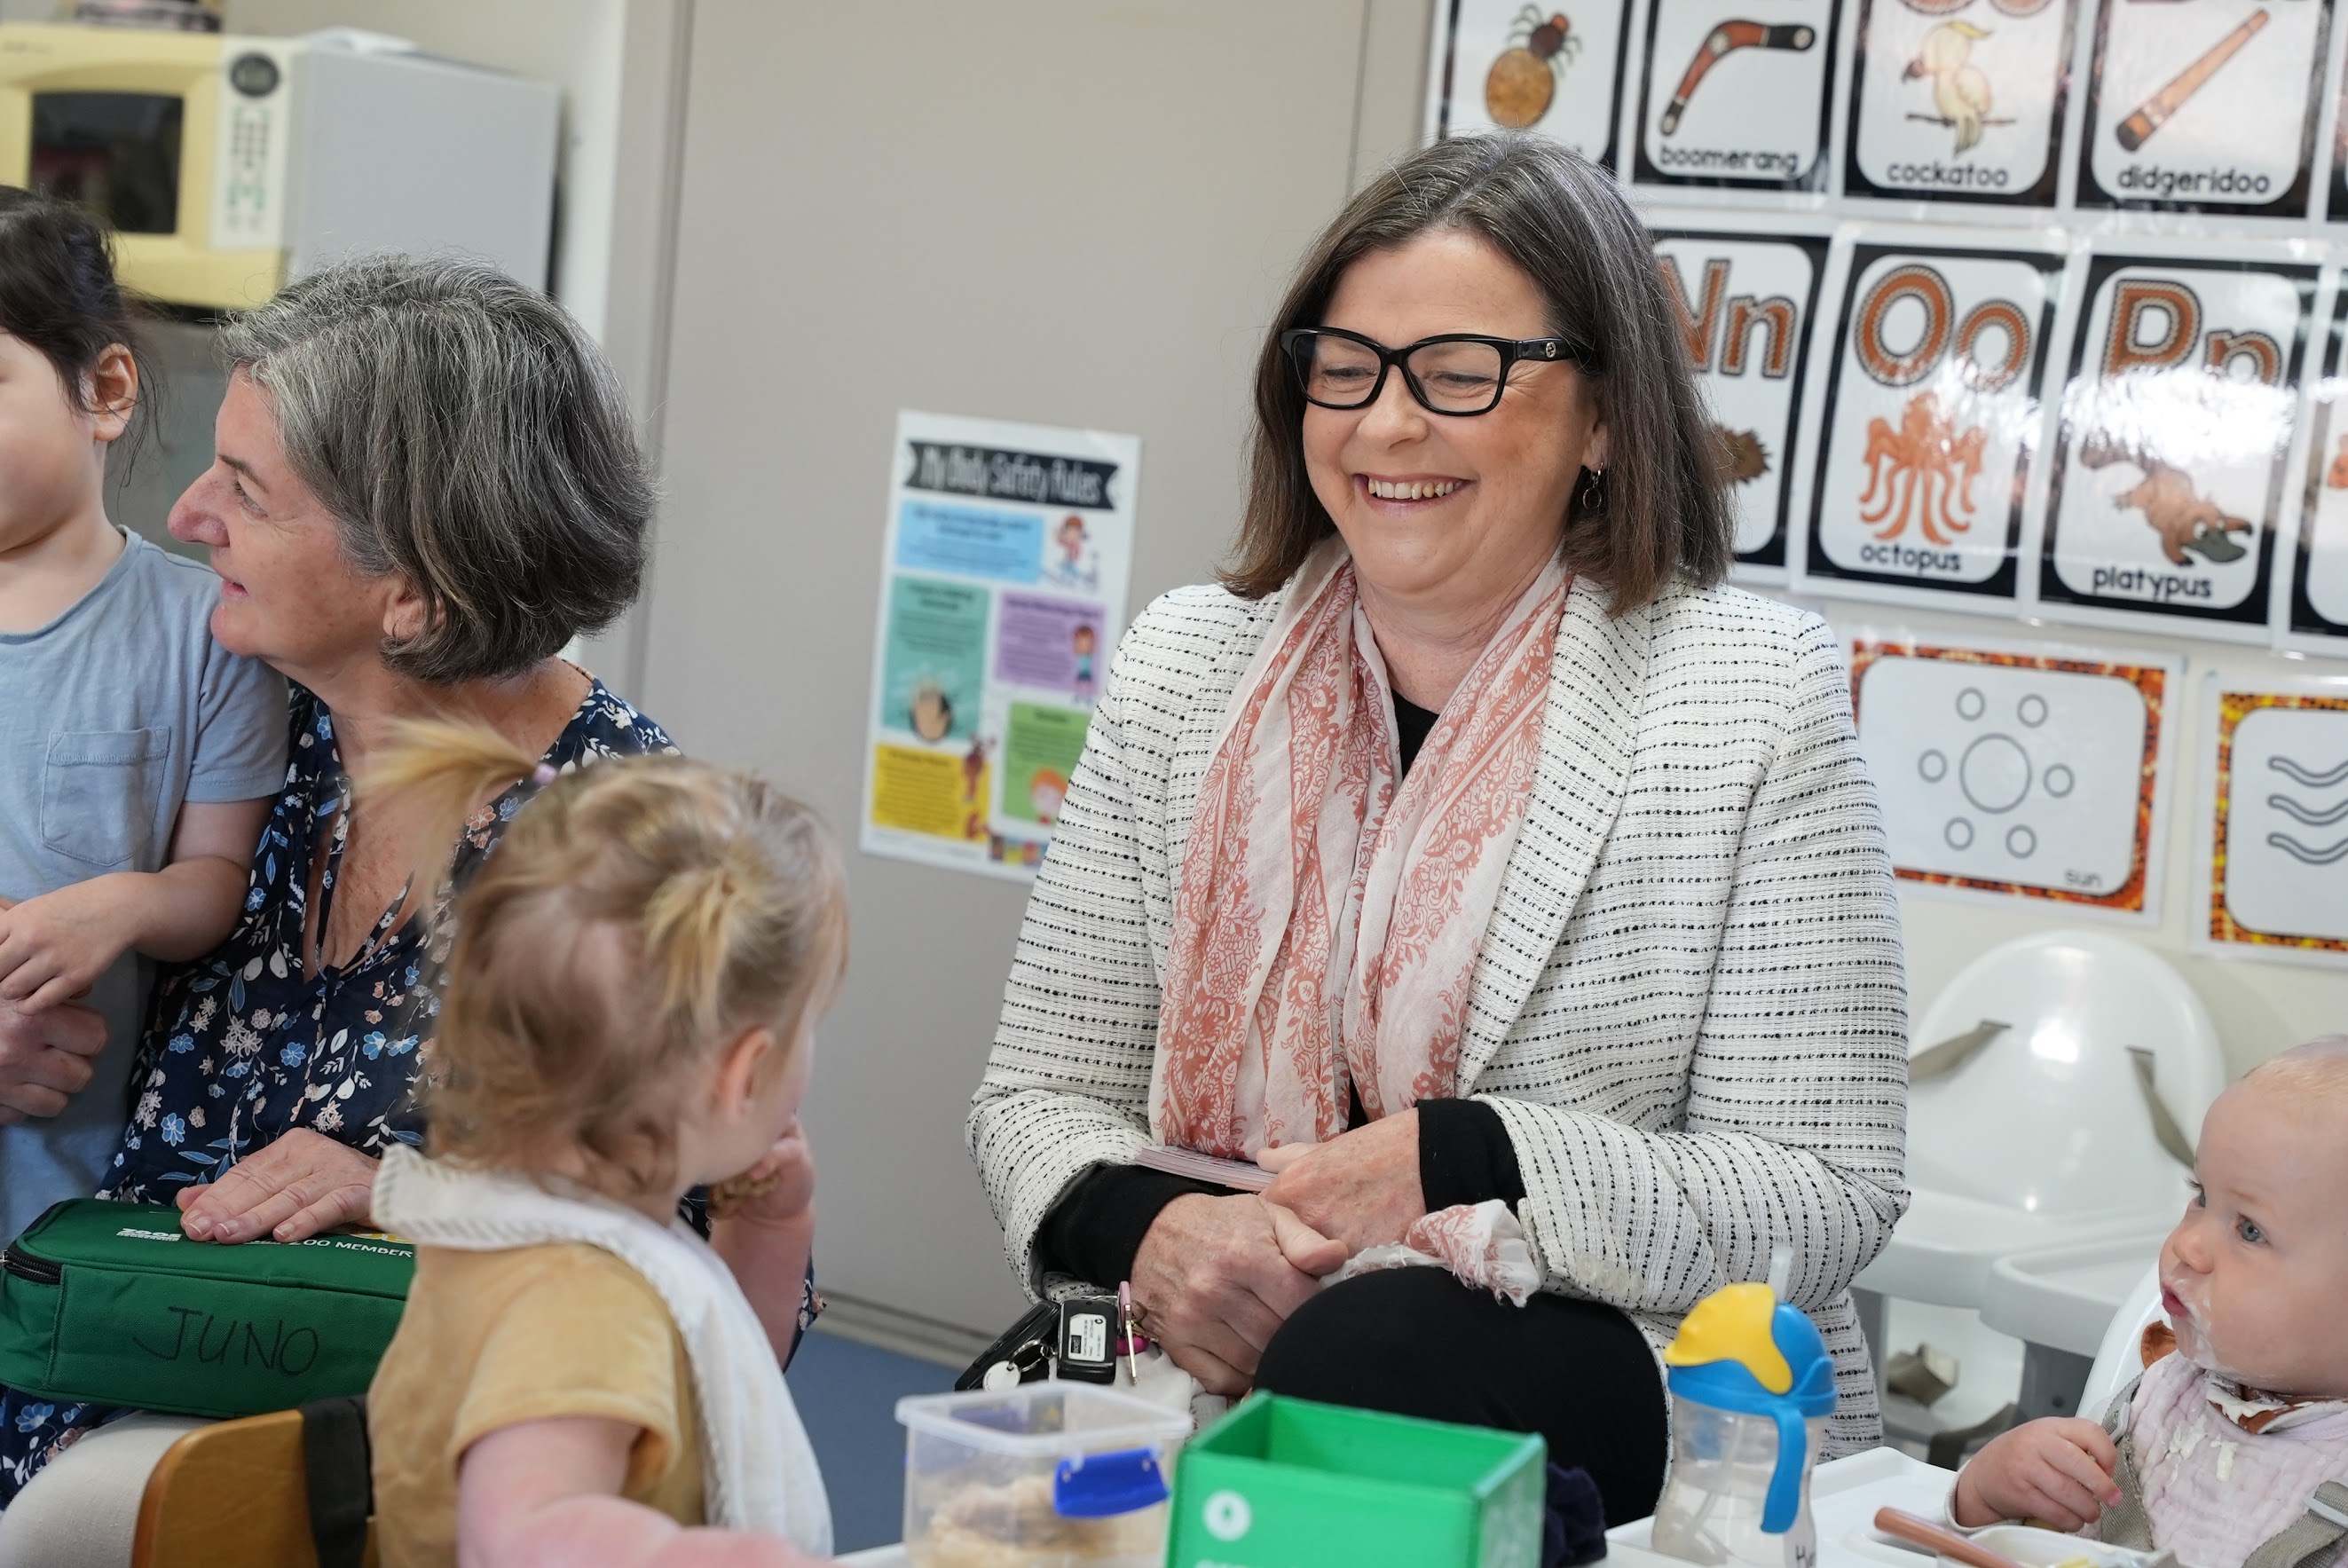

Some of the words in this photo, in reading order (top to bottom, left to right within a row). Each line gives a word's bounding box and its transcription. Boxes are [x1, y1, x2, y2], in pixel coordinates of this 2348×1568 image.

[1660, 145, 1799, 177] boomerang
[1887, 160, 2009, 187] cockatoo
[2117, 165, 2271, 197] didgeridoo
[1855, 264, 2031, 393] Oo
[1860, 544, 1961, 576] octopus
[2092, 566, 2212, 603] platypus
[2065, 869, 2102, 887] sun
[335, 1241, 414, 1258] MEMBER
[132, 1305, 319, 1376] JUNO
